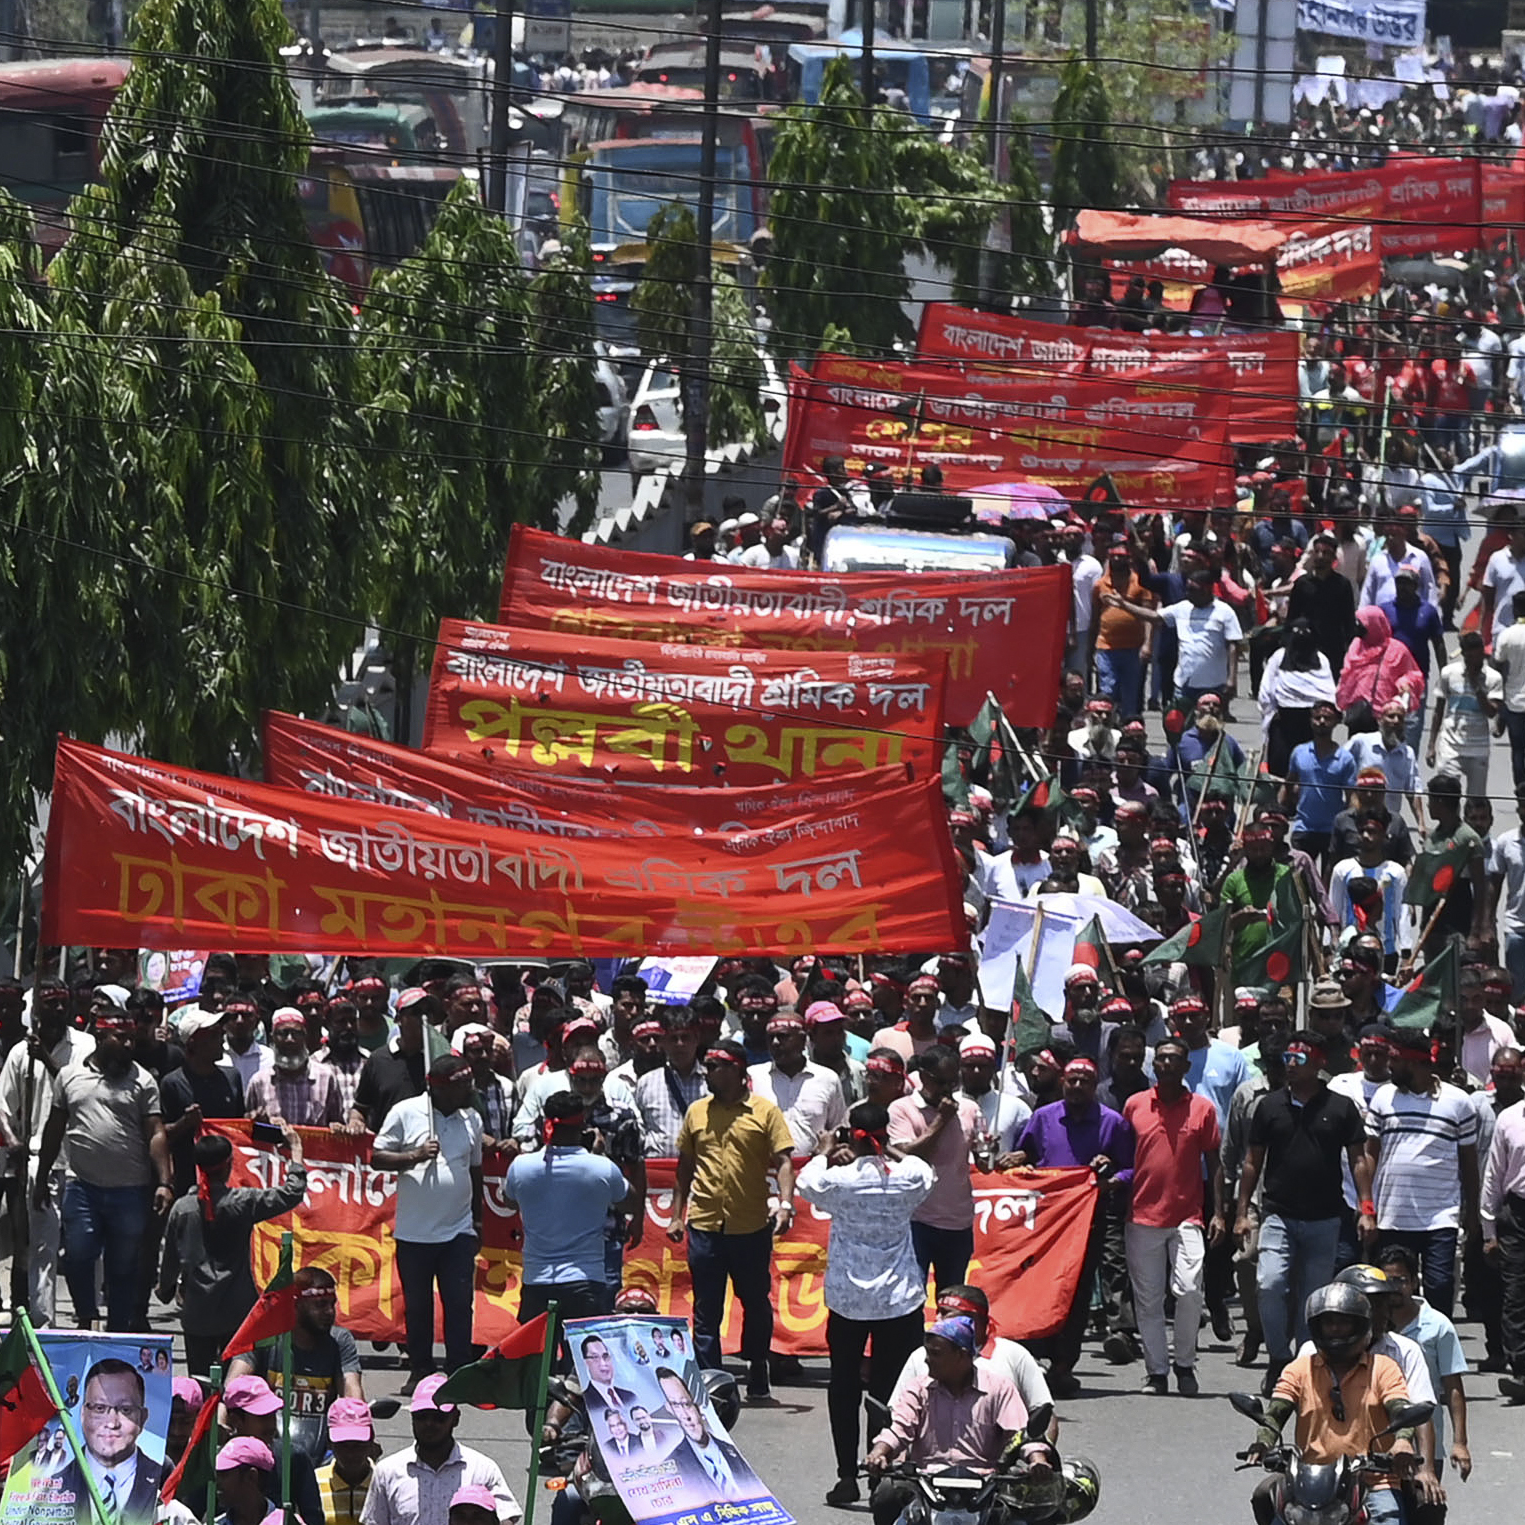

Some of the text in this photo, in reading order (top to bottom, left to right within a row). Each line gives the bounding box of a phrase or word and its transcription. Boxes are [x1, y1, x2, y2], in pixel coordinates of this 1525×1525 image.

[826, 383, 912, 410] বাংলাদে
[539, 557, 660, 603] বাংলাদেশ
[667, 574, 846, 626] জাতীয়তাবাদী
[958, 596, 1016, 628] দল
[446, 650, 931, 716] বাংলাদেশ জাতীয়তাবাদী শ্রমিক দল
[458, 694, 701, 773] পল্লবী
[723, 722, 907, 779] থানা
[107, 785, 299, 860] বাংলাদেশ
[317, 820, 584, 897] জাতীয়তাবাদী
[768, 848, 863, 899] দল
[795, 811, 861, 842] জিন্দাবাদ
[111, 850, 288, 942] ঢাকা
